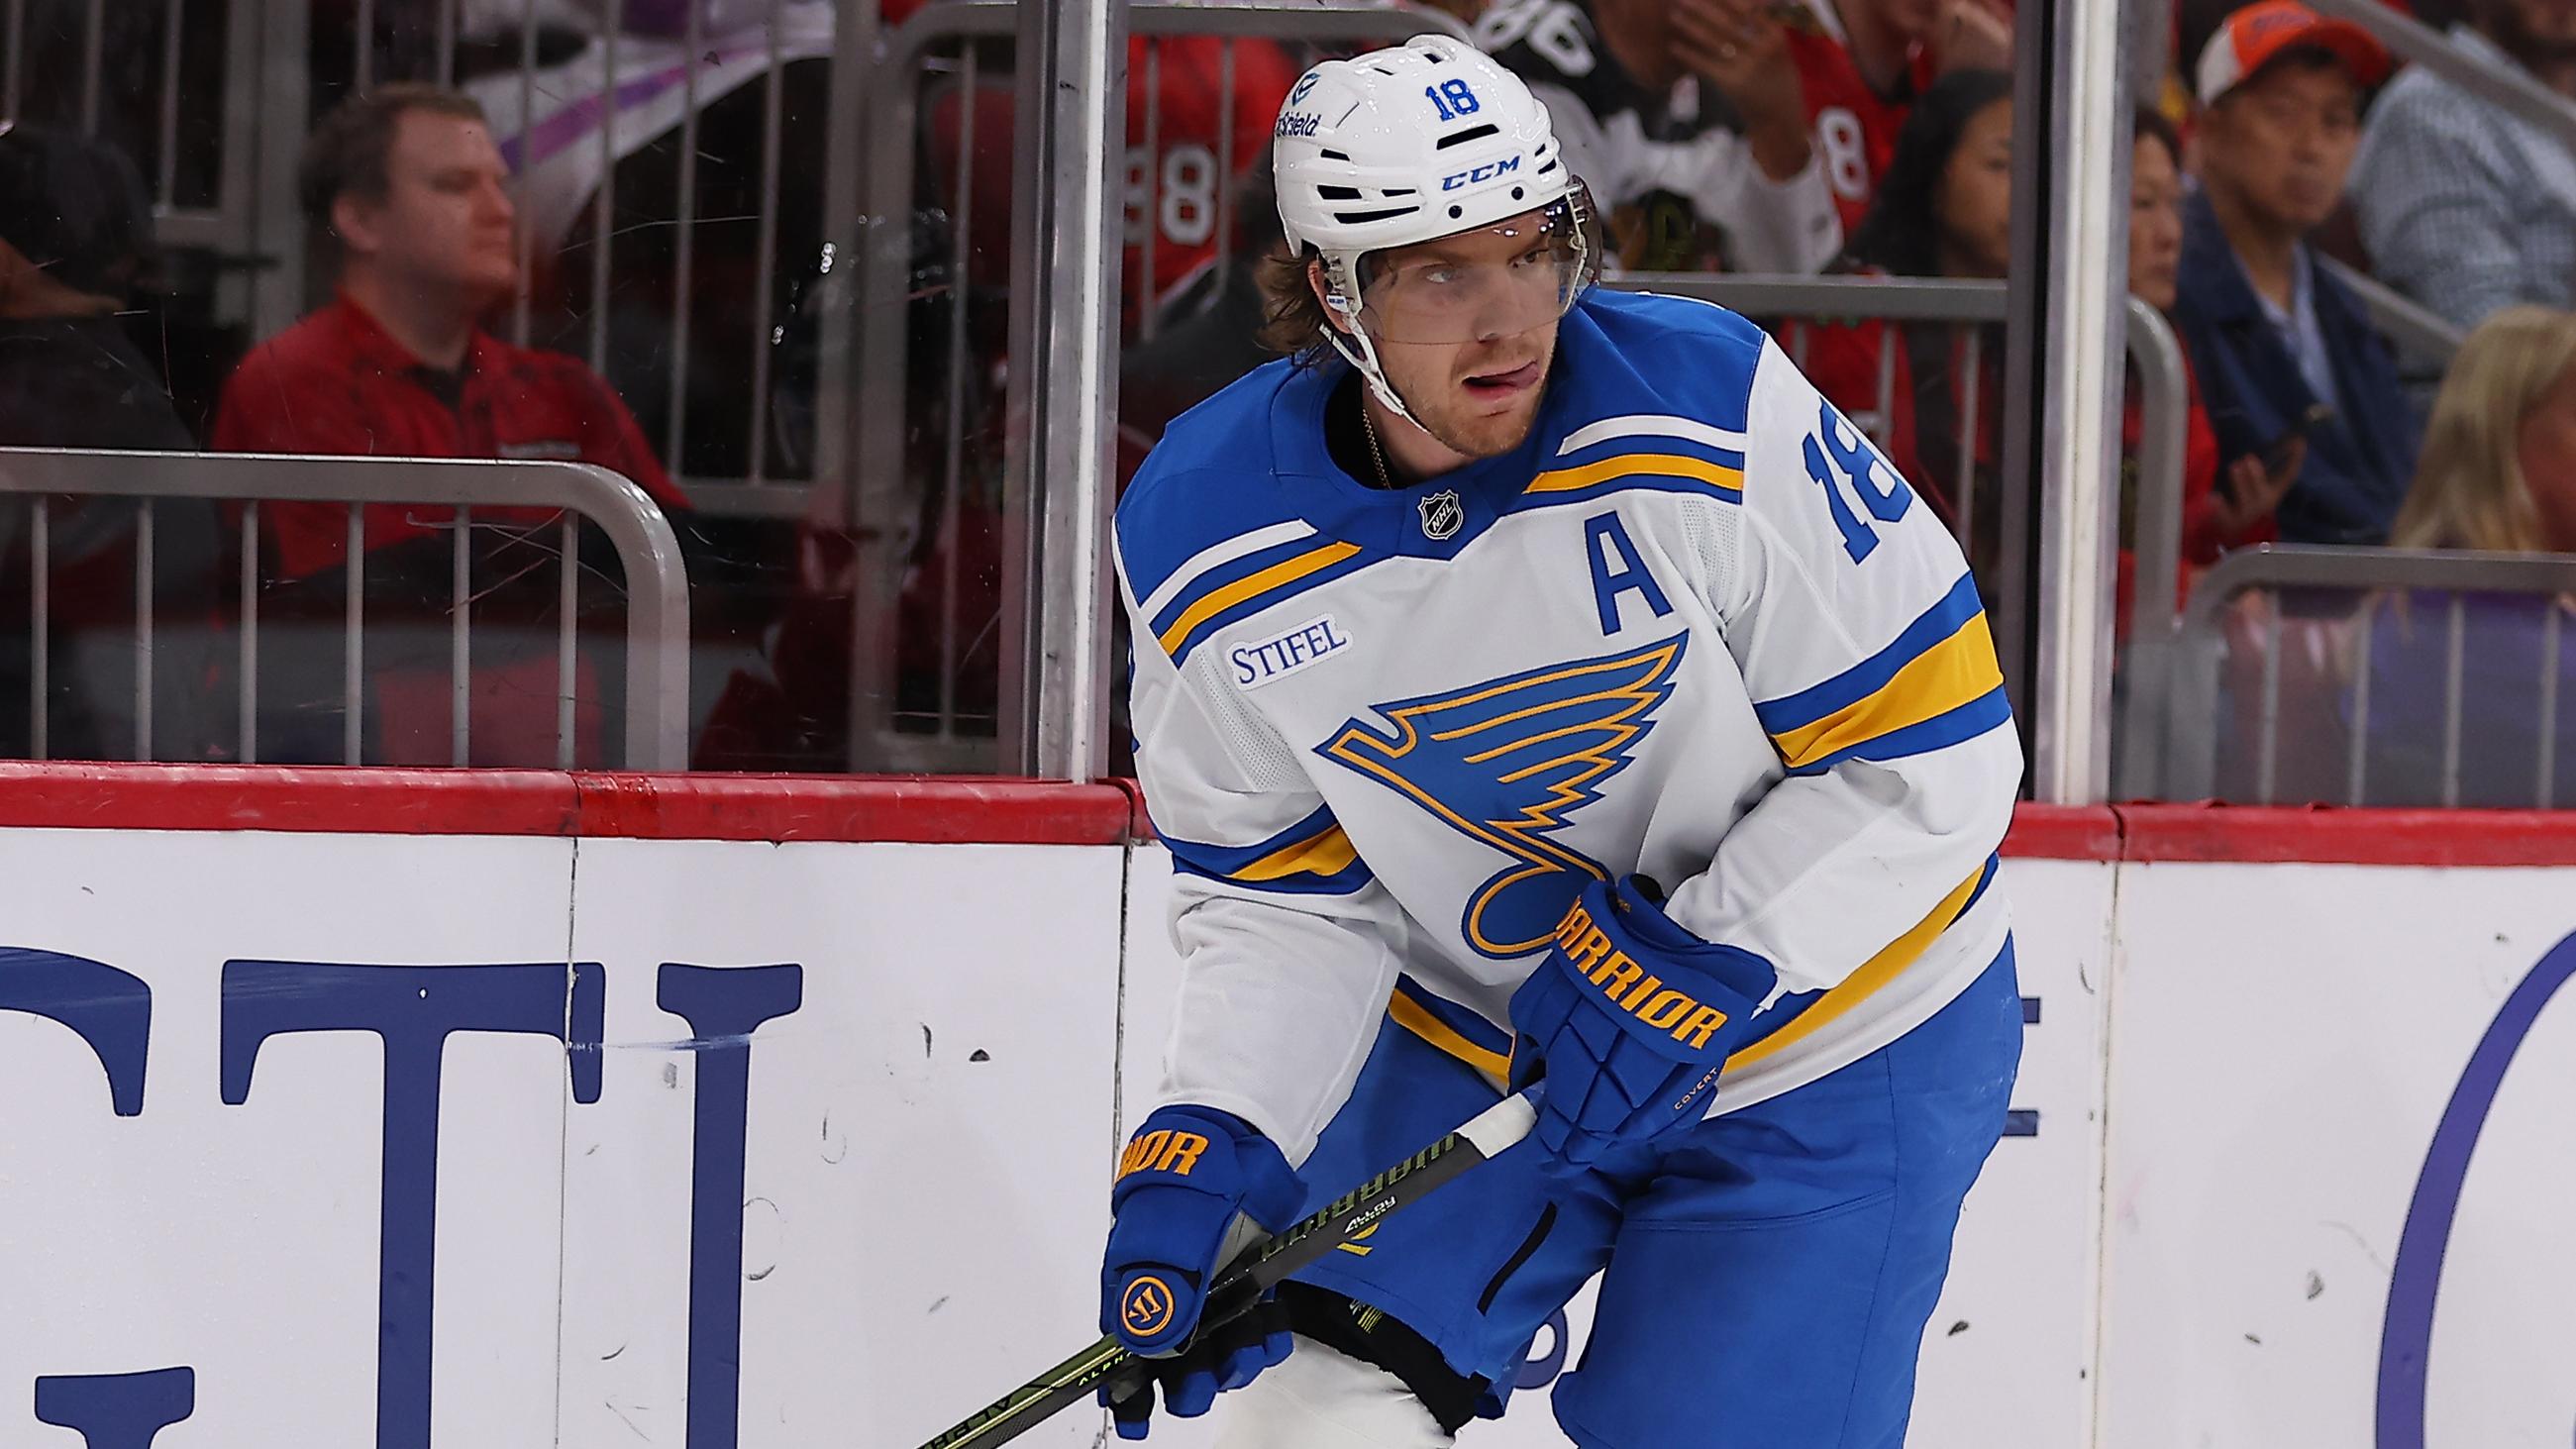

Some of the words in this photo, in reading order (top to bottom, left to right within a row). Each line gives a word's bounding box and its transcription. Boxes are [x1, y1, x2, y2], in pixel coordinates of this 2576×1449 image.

[1425, 78, 1481, 122] 18
[1442, 155, 1520, 191] CCM
[1802, 396, 1913, 566] 18
[1432, 503, 1453, 532] NHL
[1585, 510, 1674, 637] A
[1231, 620, 1347, 684] STIFEL
[1556, 895, 1728, 1051] ARRIOR
[1674, 1067, 1717, 1110] COVERT
[1345, 1195, 1397, 1233] ALLOY
